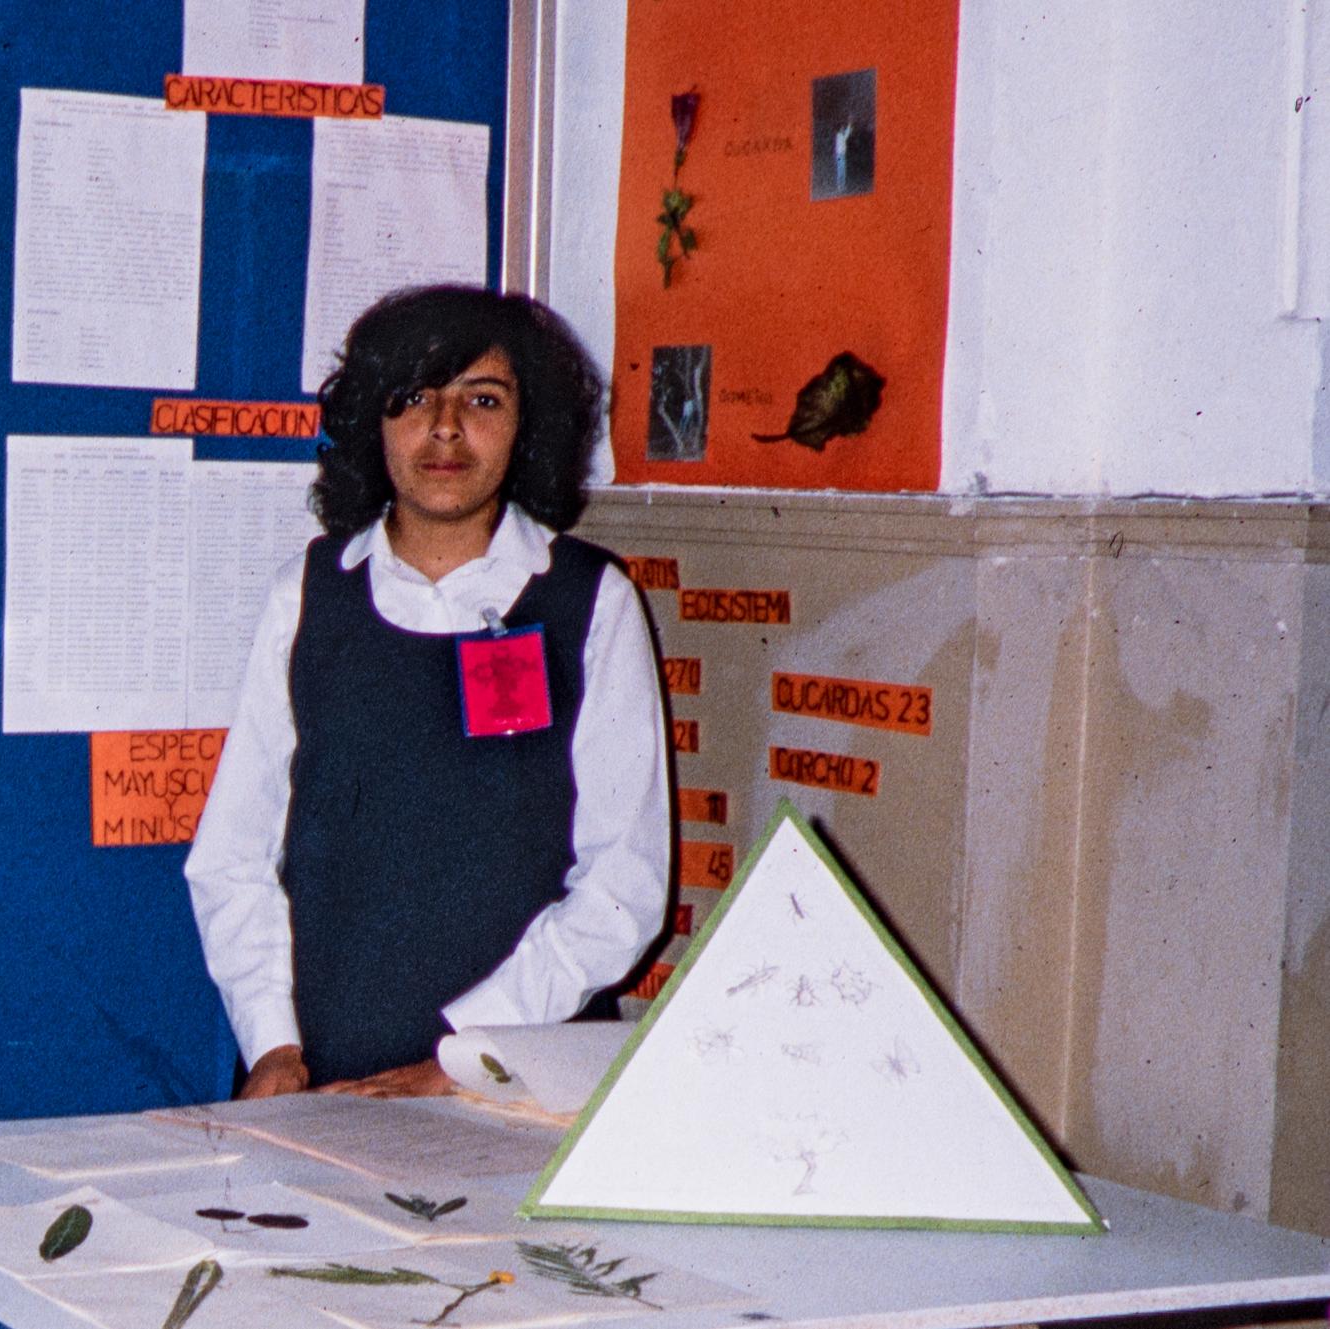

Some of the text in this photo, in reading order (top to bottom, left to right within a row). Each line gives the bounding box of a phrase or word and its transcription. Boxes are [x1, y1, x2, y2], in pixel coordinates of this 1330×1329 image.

[166, 78, 382, 116] CARACTERISTICAS
[155, 403, 318, 437] CLASIFICACION
[681, 591, 790, 623] ECOSISTEMA
[776, 676, 931, 725] CUCARDAS 23
[775, 747, 877, 793] CORCHO 2
[165, 795, 178, 820] Y
[103, 814, 203, 846] MINUS
[707, 851, 732, 882] 45
